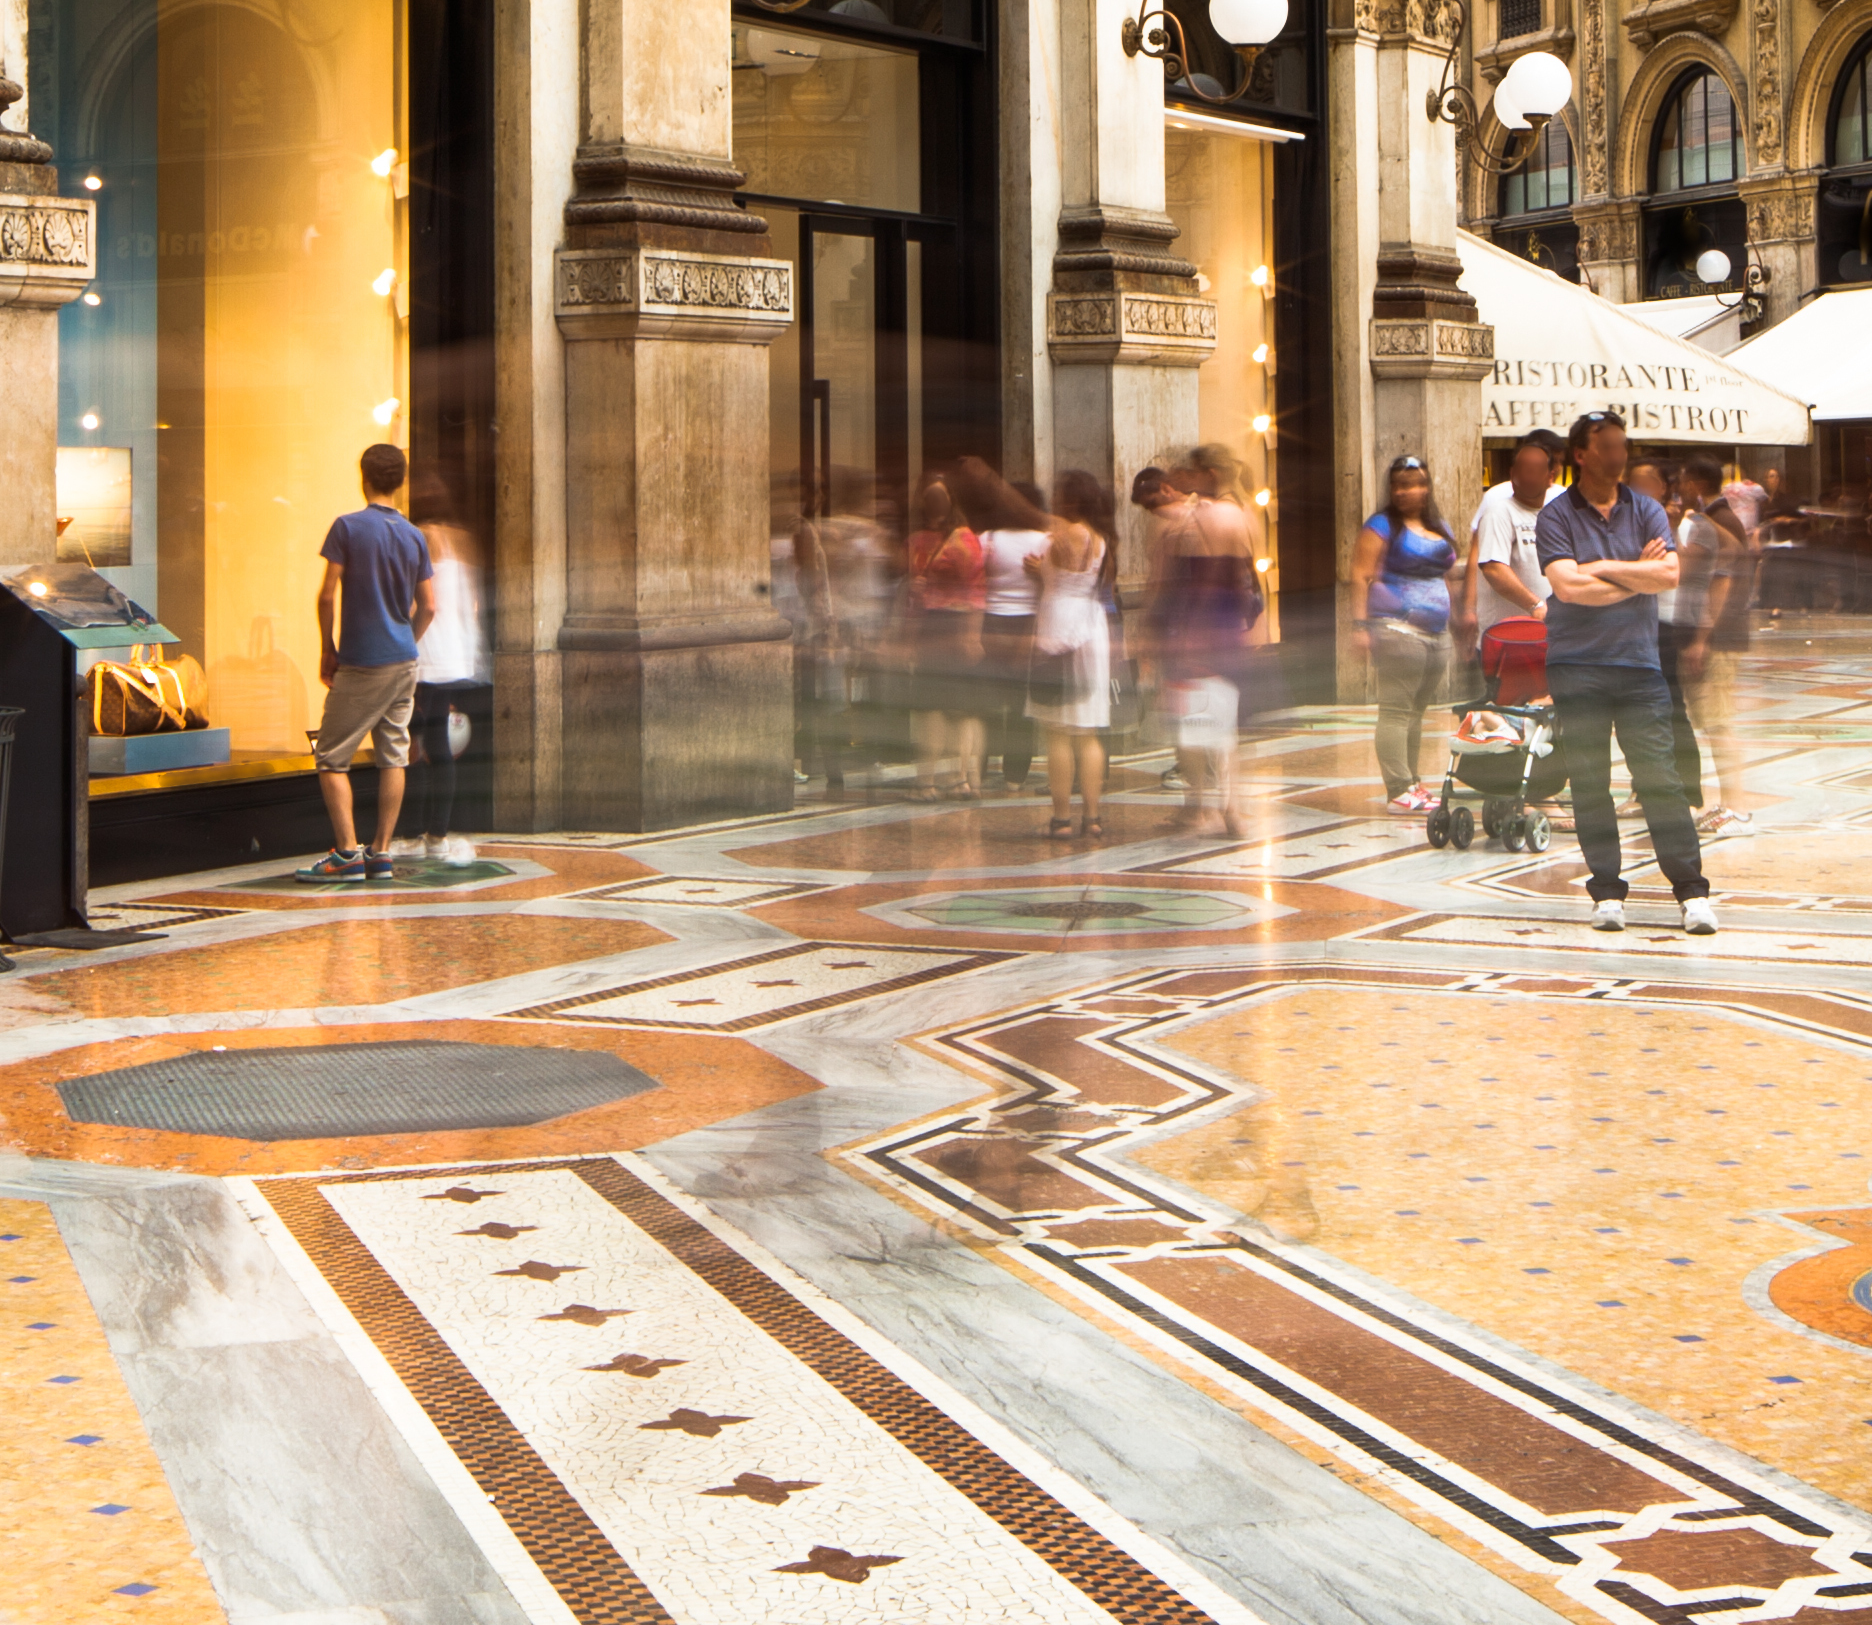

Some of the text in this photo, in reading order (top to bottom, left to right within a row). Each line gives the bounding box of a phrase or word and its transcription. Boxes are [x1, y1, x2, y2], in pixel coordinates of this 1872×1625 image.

[1690, 279, 1734, 295] RISTONTE
[1492, 359, 1699, 392] RISTORANTE
[1479, 400, 1577, 427] AFFE'
